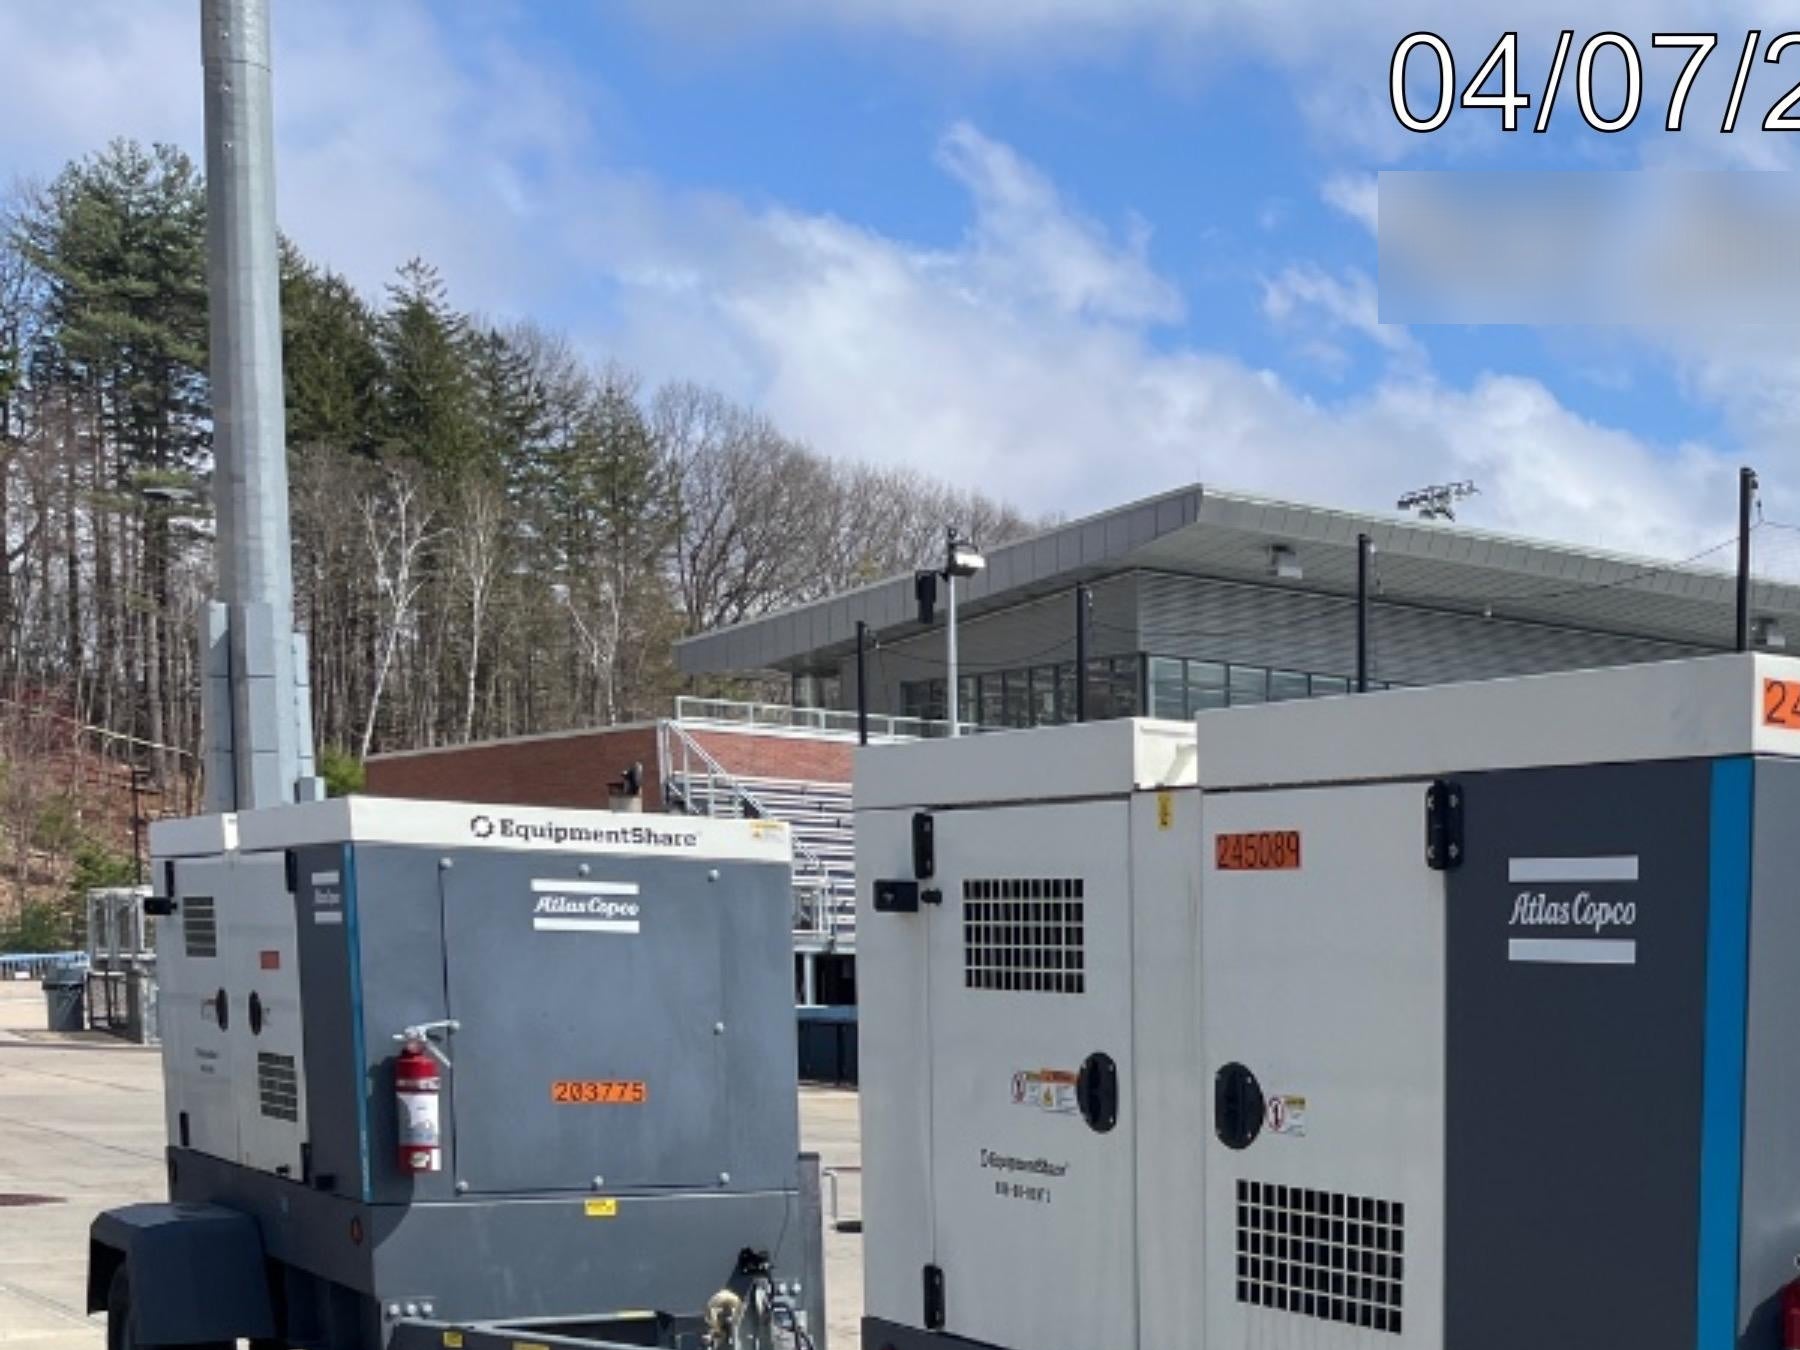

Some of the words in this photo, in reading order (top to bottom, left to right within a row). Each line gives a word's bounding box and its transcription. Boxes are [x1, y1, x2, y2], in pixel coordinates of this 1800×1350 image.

[500, 818, 697, 847] EquipmentShare
[1217, 831, 1300, 869] 245089
[1508, 891, 1569, 925] Atlas
[1572, 891, 1637, 934] Copco
[555, 1082, 643, 1102] 203775
